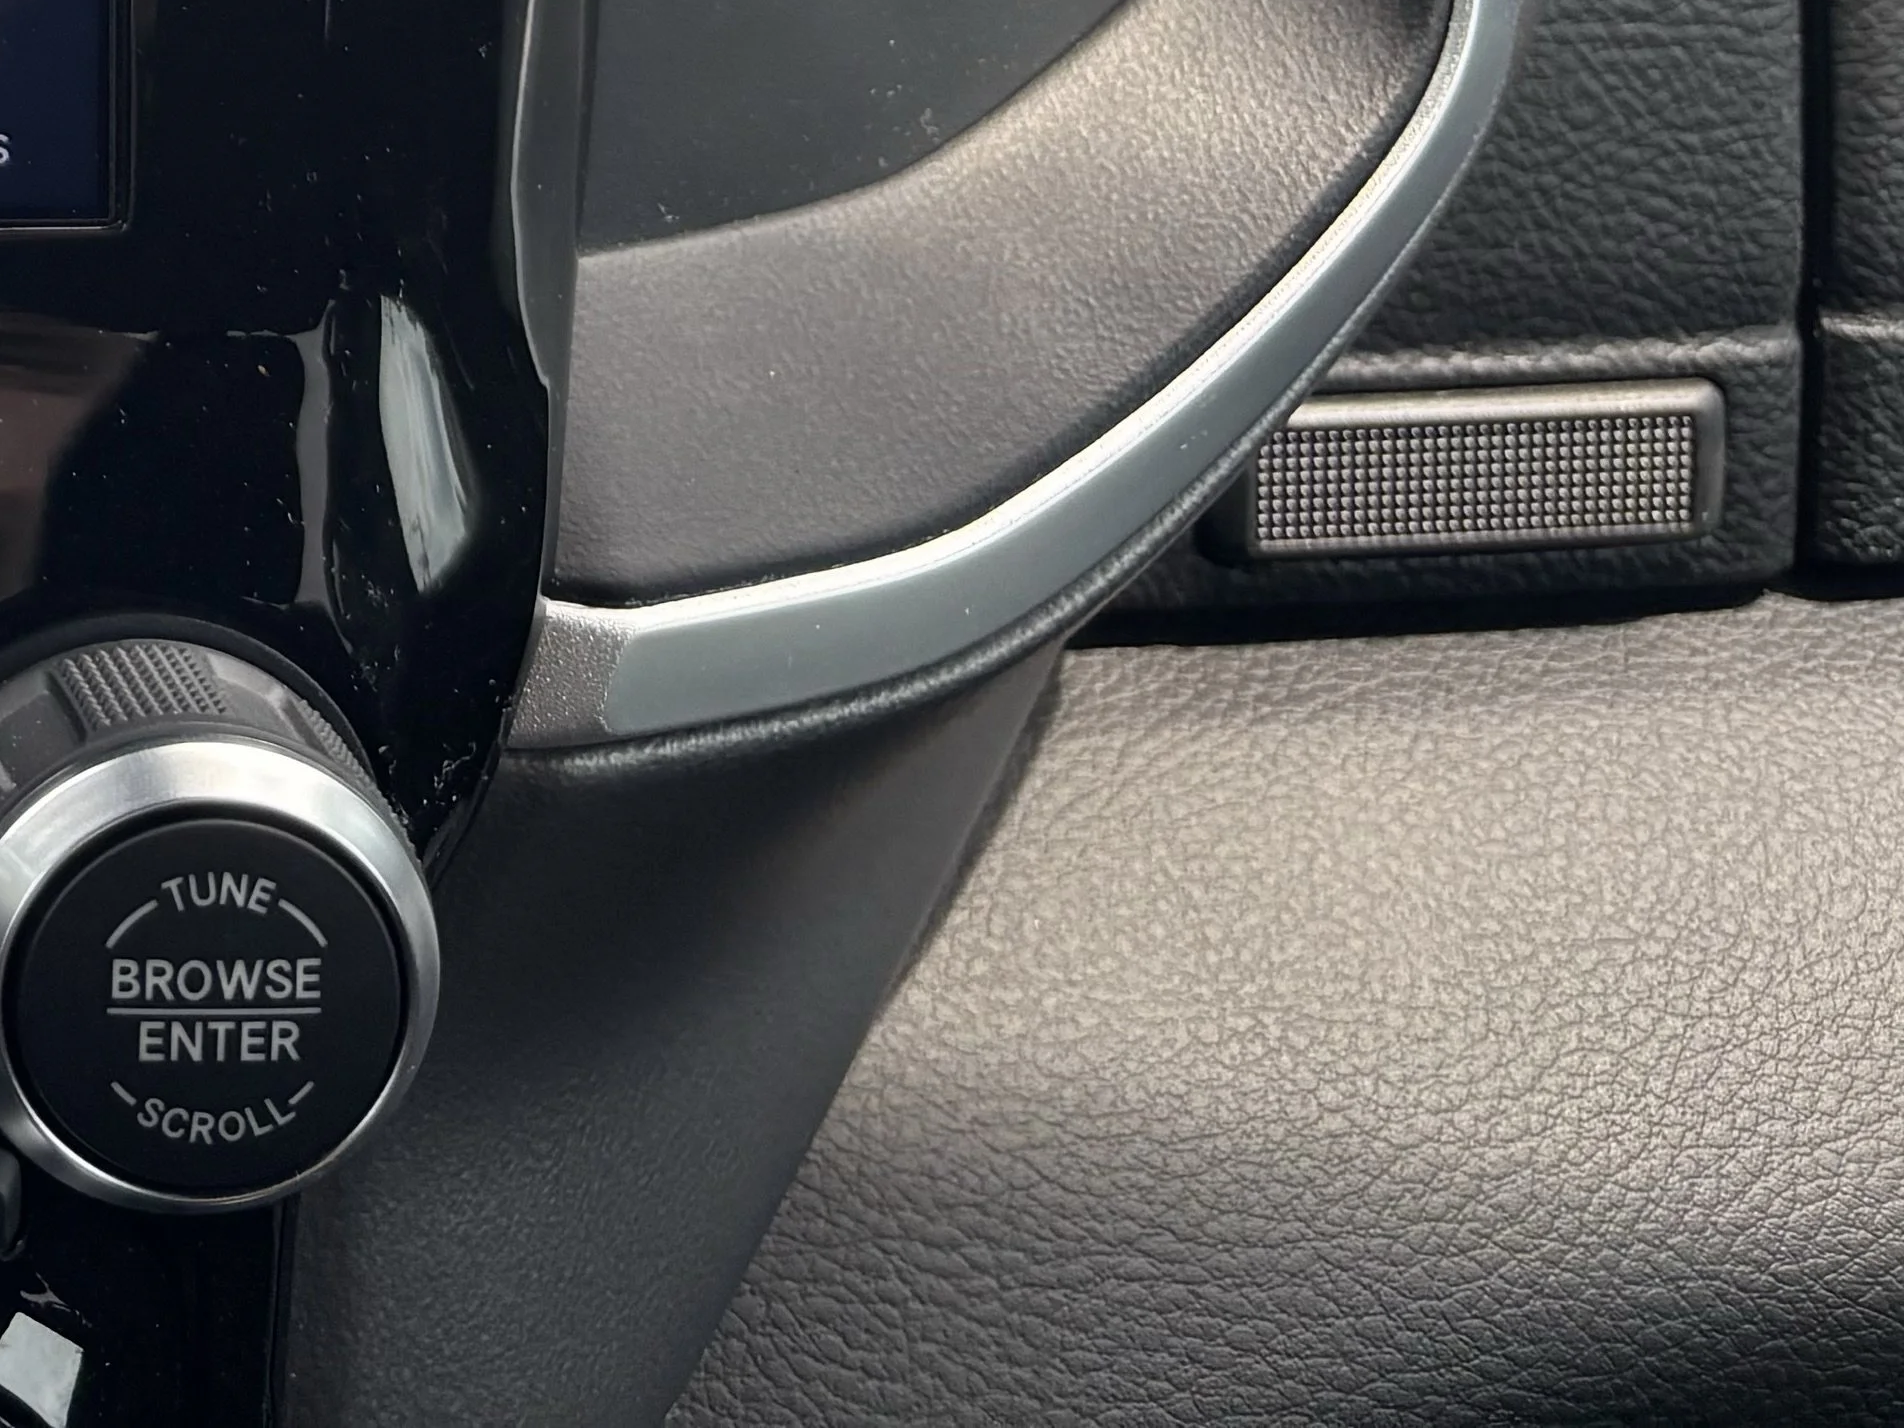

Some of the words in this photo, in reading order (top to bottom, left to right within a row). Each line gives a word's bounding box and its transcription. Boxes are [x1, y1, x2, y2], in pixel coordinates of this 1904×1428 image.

[161, 873, 277, 916] TUNE
[111, 957, 321, 1000] BROWSE
[138, 1022, 299, 1062] ENTER
[136, 1097, 296, 1143] SCROLL
